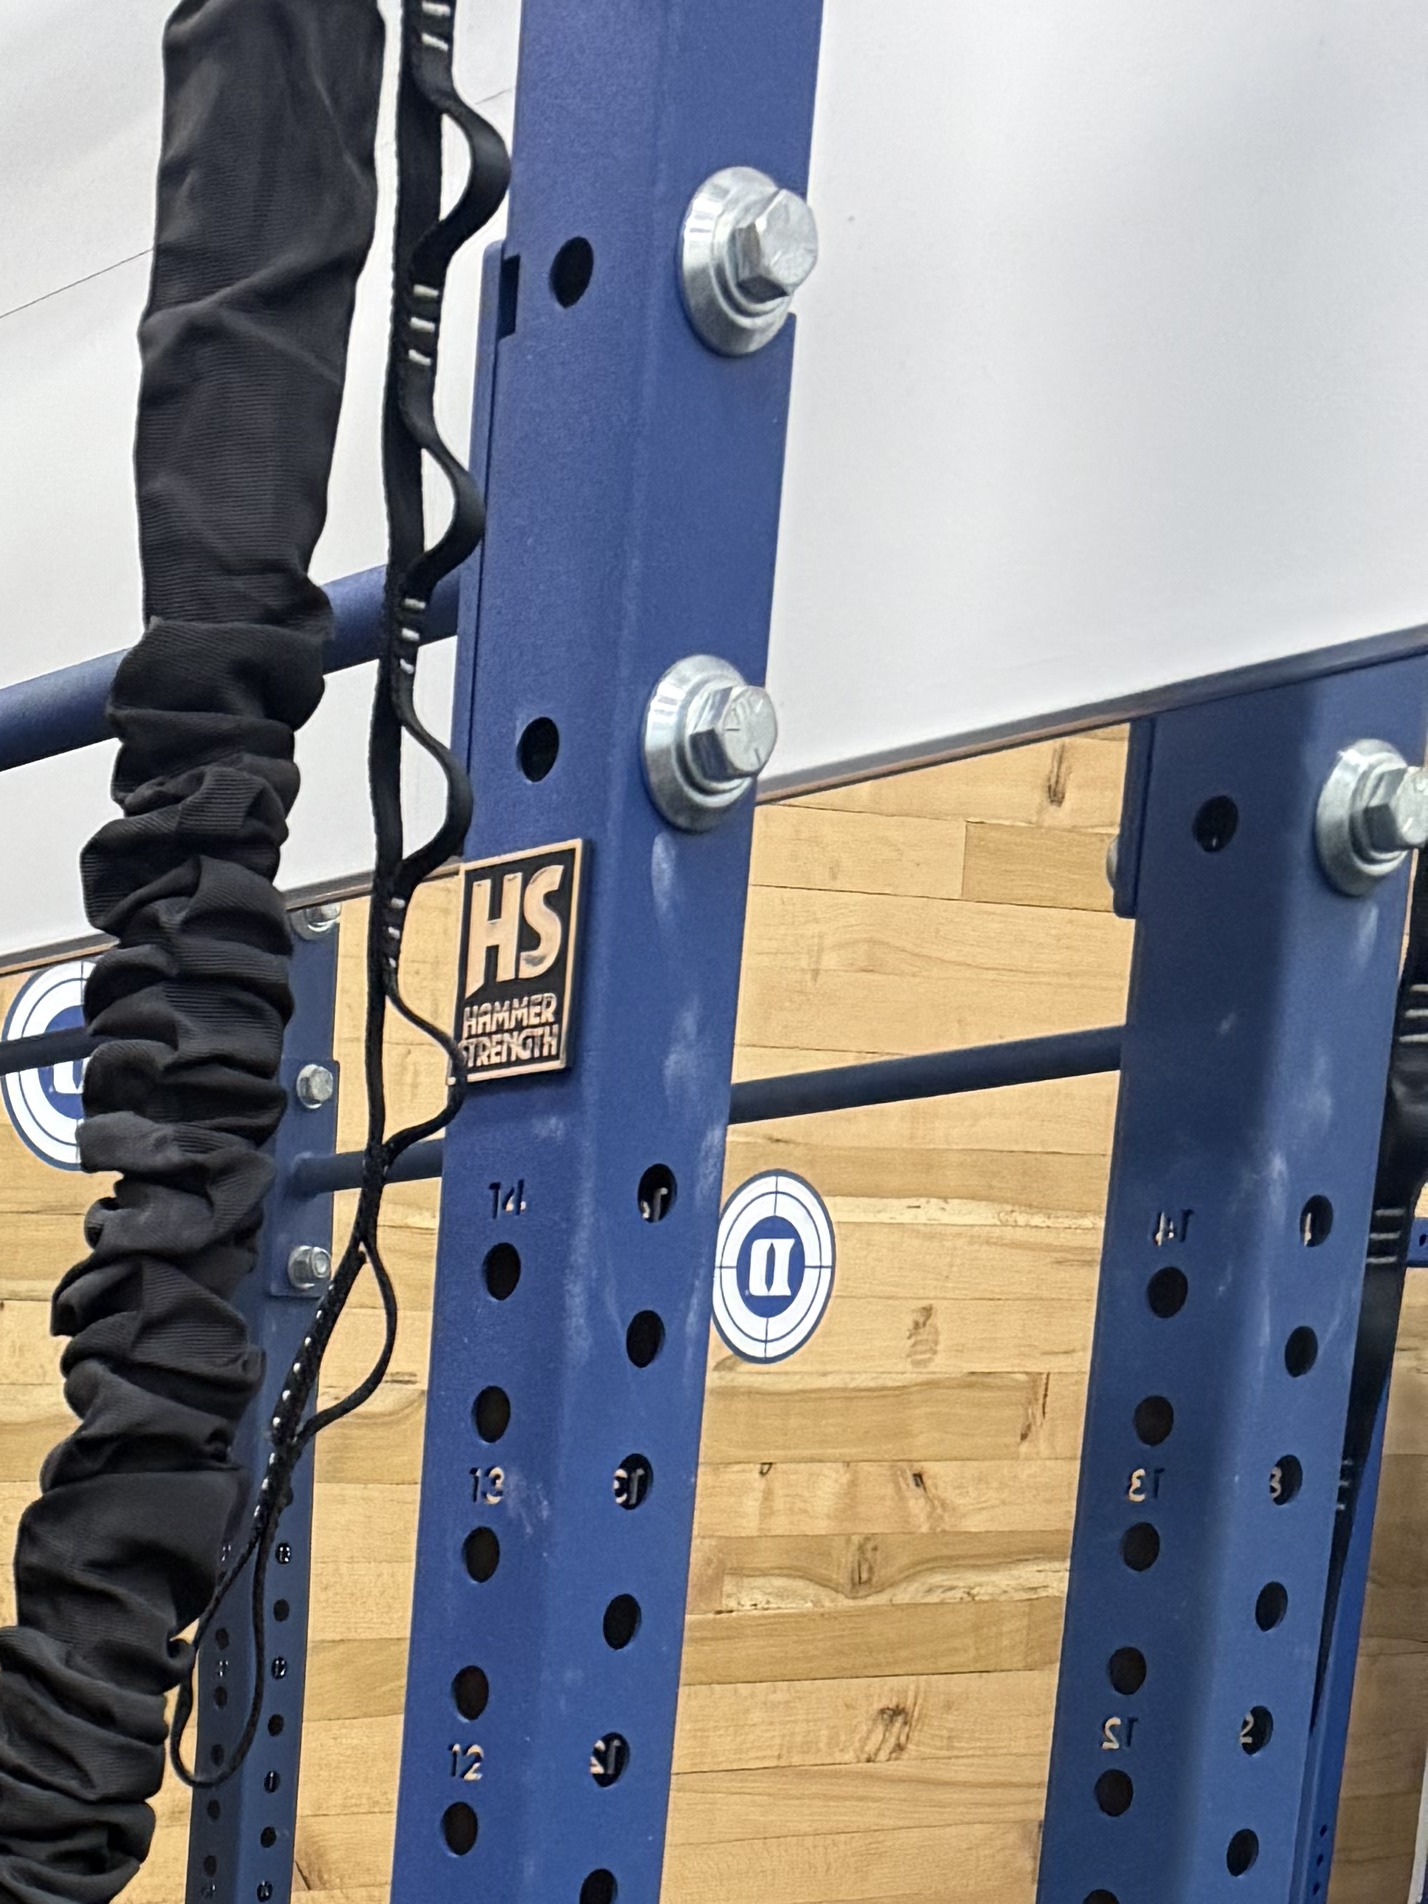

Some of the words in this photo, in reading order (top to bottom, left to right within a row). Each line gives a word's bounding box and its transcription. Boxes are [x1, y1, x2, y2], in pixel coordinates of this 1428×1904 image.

[465, 865, 564, 999] HS
[463, 993, 557, 1040] HAMMER
[458, 1024, 558, 1067] STRENGTH
[489, 1180, 526, 1219] 14
[469, 1466, 504, 1504] 13
[447, 1743, 484, 1781] 12
